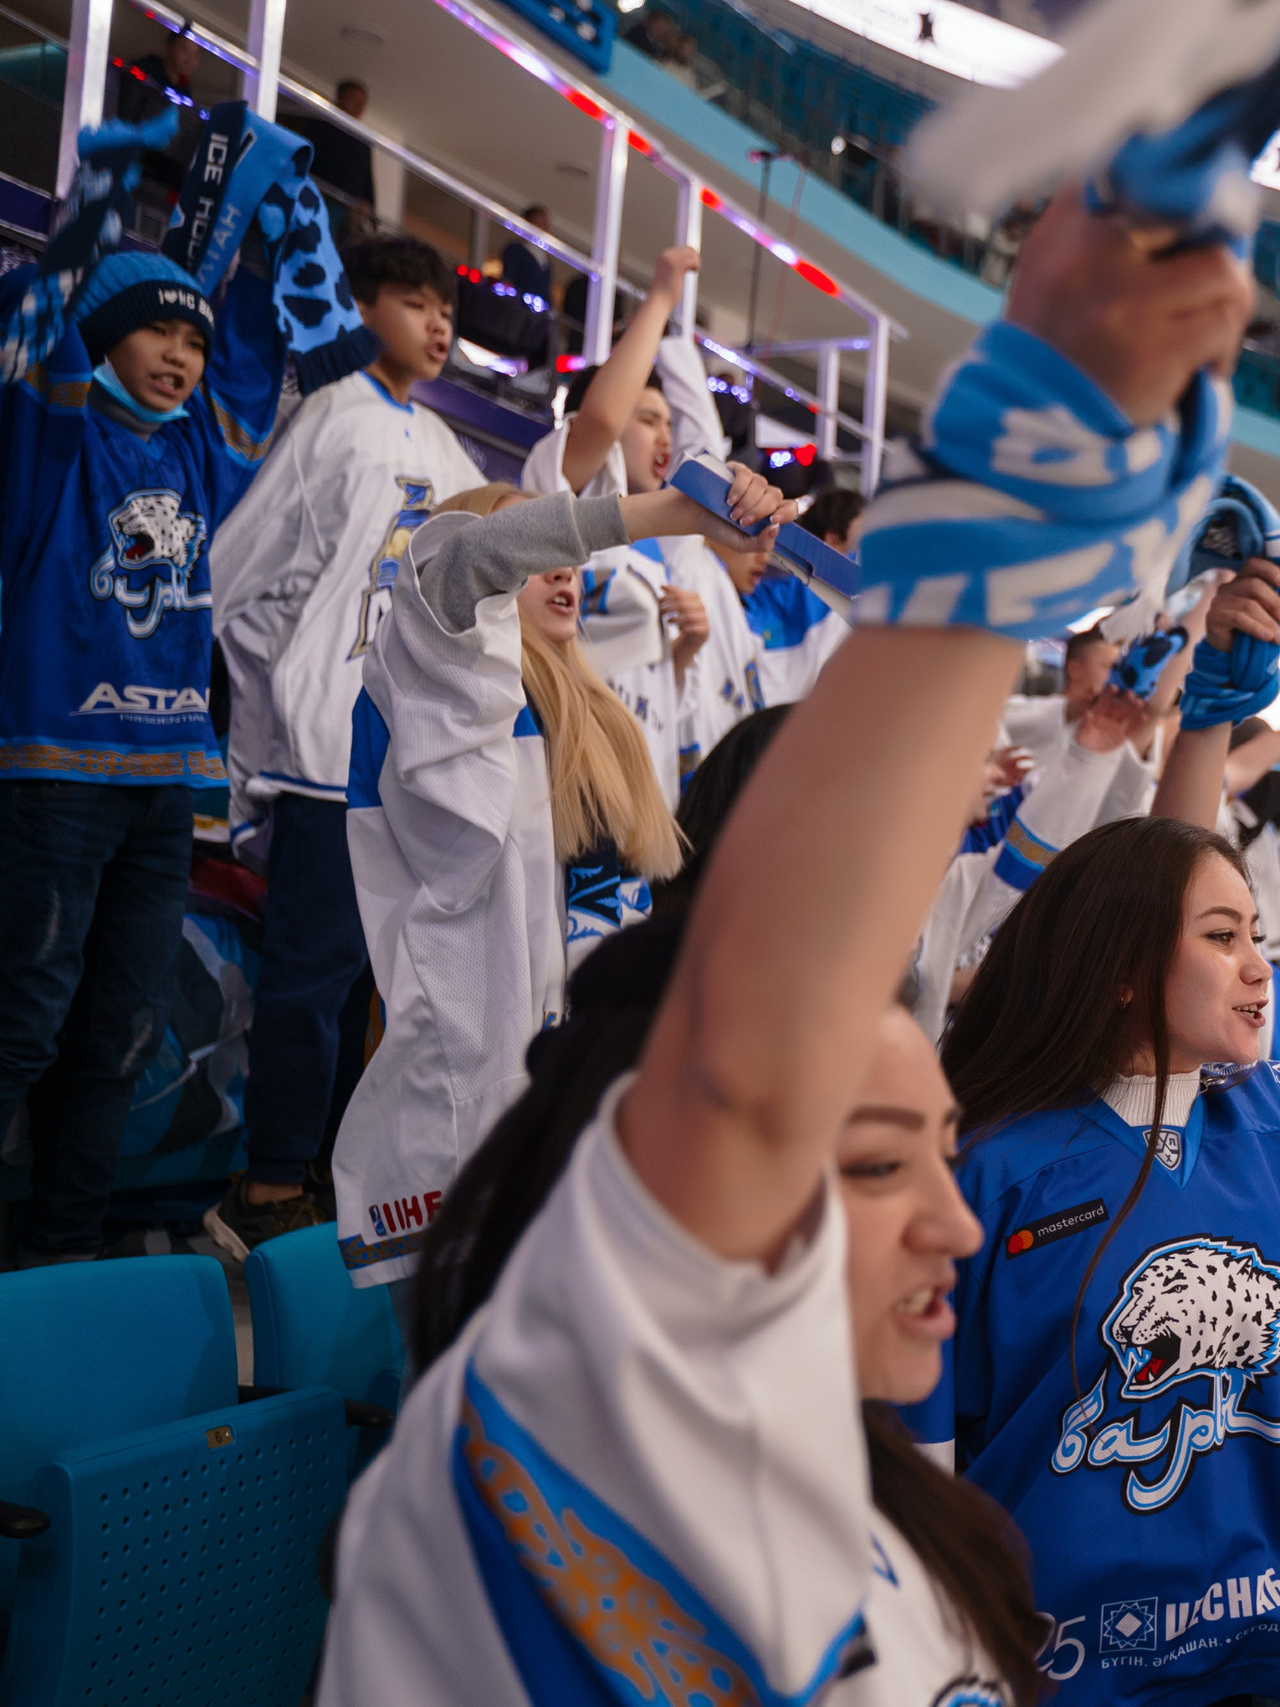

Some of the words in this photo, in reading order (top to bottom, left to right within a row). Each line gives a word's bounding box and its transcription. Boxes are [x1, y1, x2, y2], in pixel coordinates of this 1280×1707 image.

[204, 132, 229, 185] ICE
[186, 196, 215, 262] HOC
[78, 681, 210, 712] ASTA
[382, 1190, 442, 1233] IIHF
[1037, 1205, 1105, 1237] mastercard
